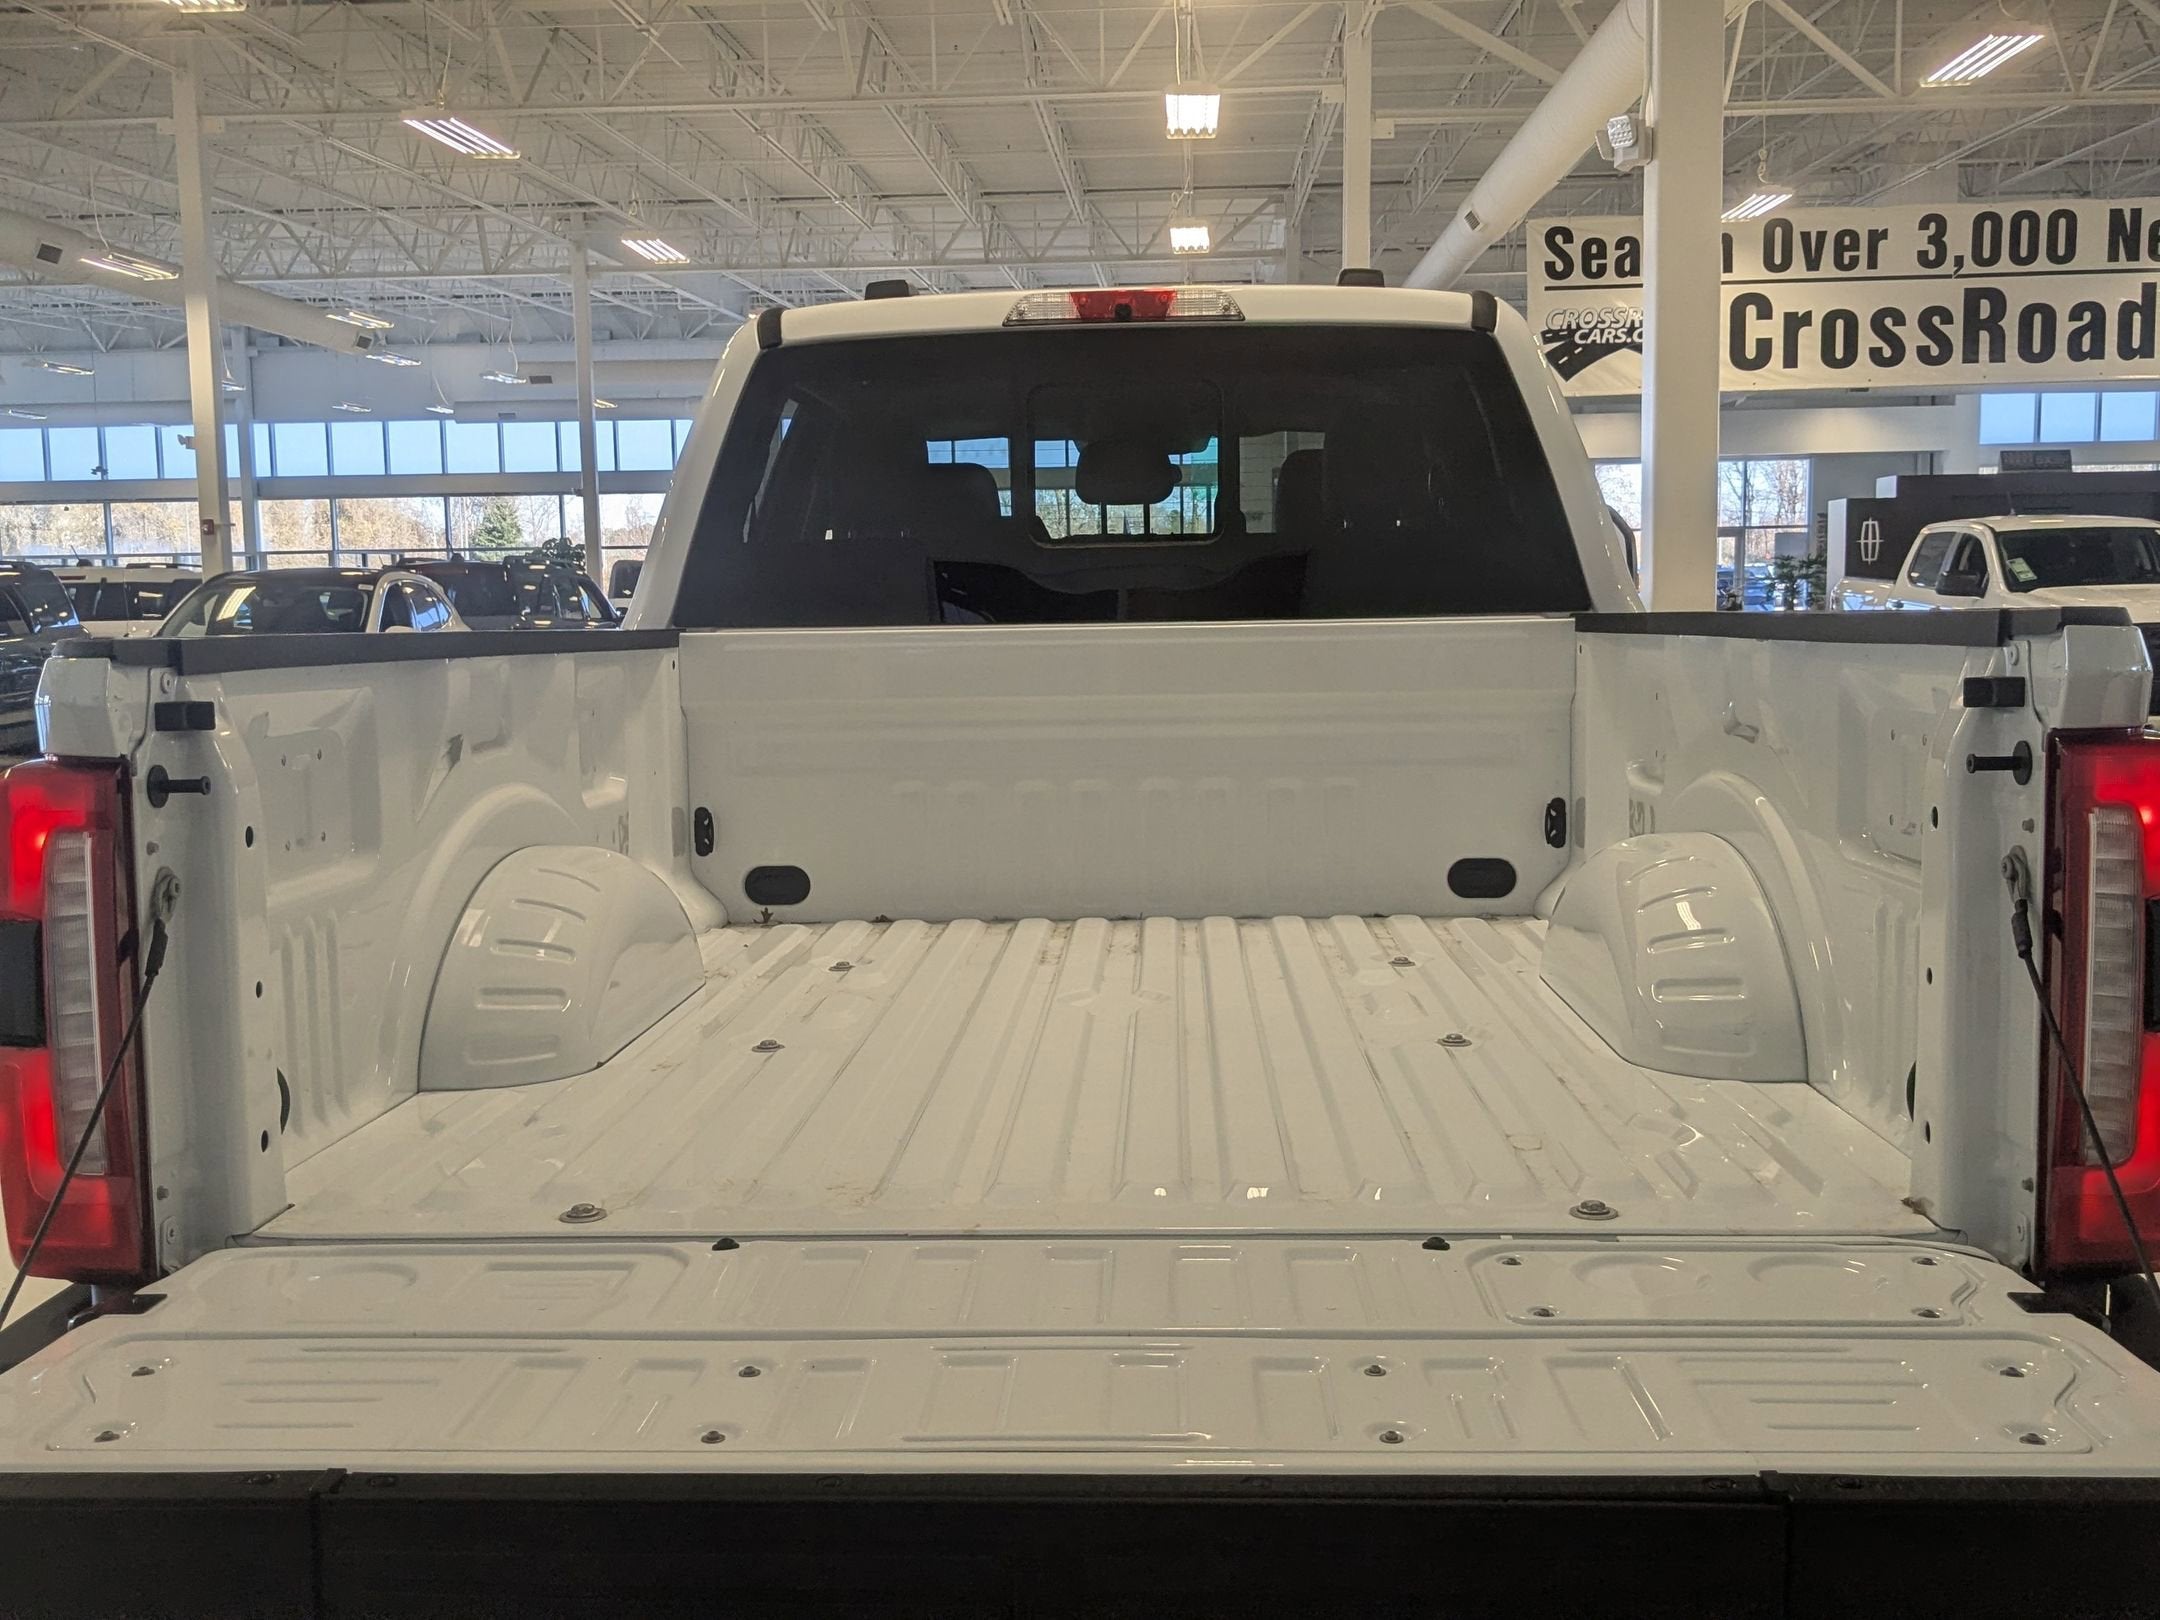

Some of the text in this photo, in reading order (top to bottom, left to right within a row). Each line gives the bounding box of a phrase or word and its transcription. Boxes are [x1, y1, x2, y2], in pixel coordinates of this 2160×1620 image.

[1762, 217, 1889, 274] Over
[1916, 208, 2078, 279] 3,000
[1729, 282, 2158, 372] CrossRoad
